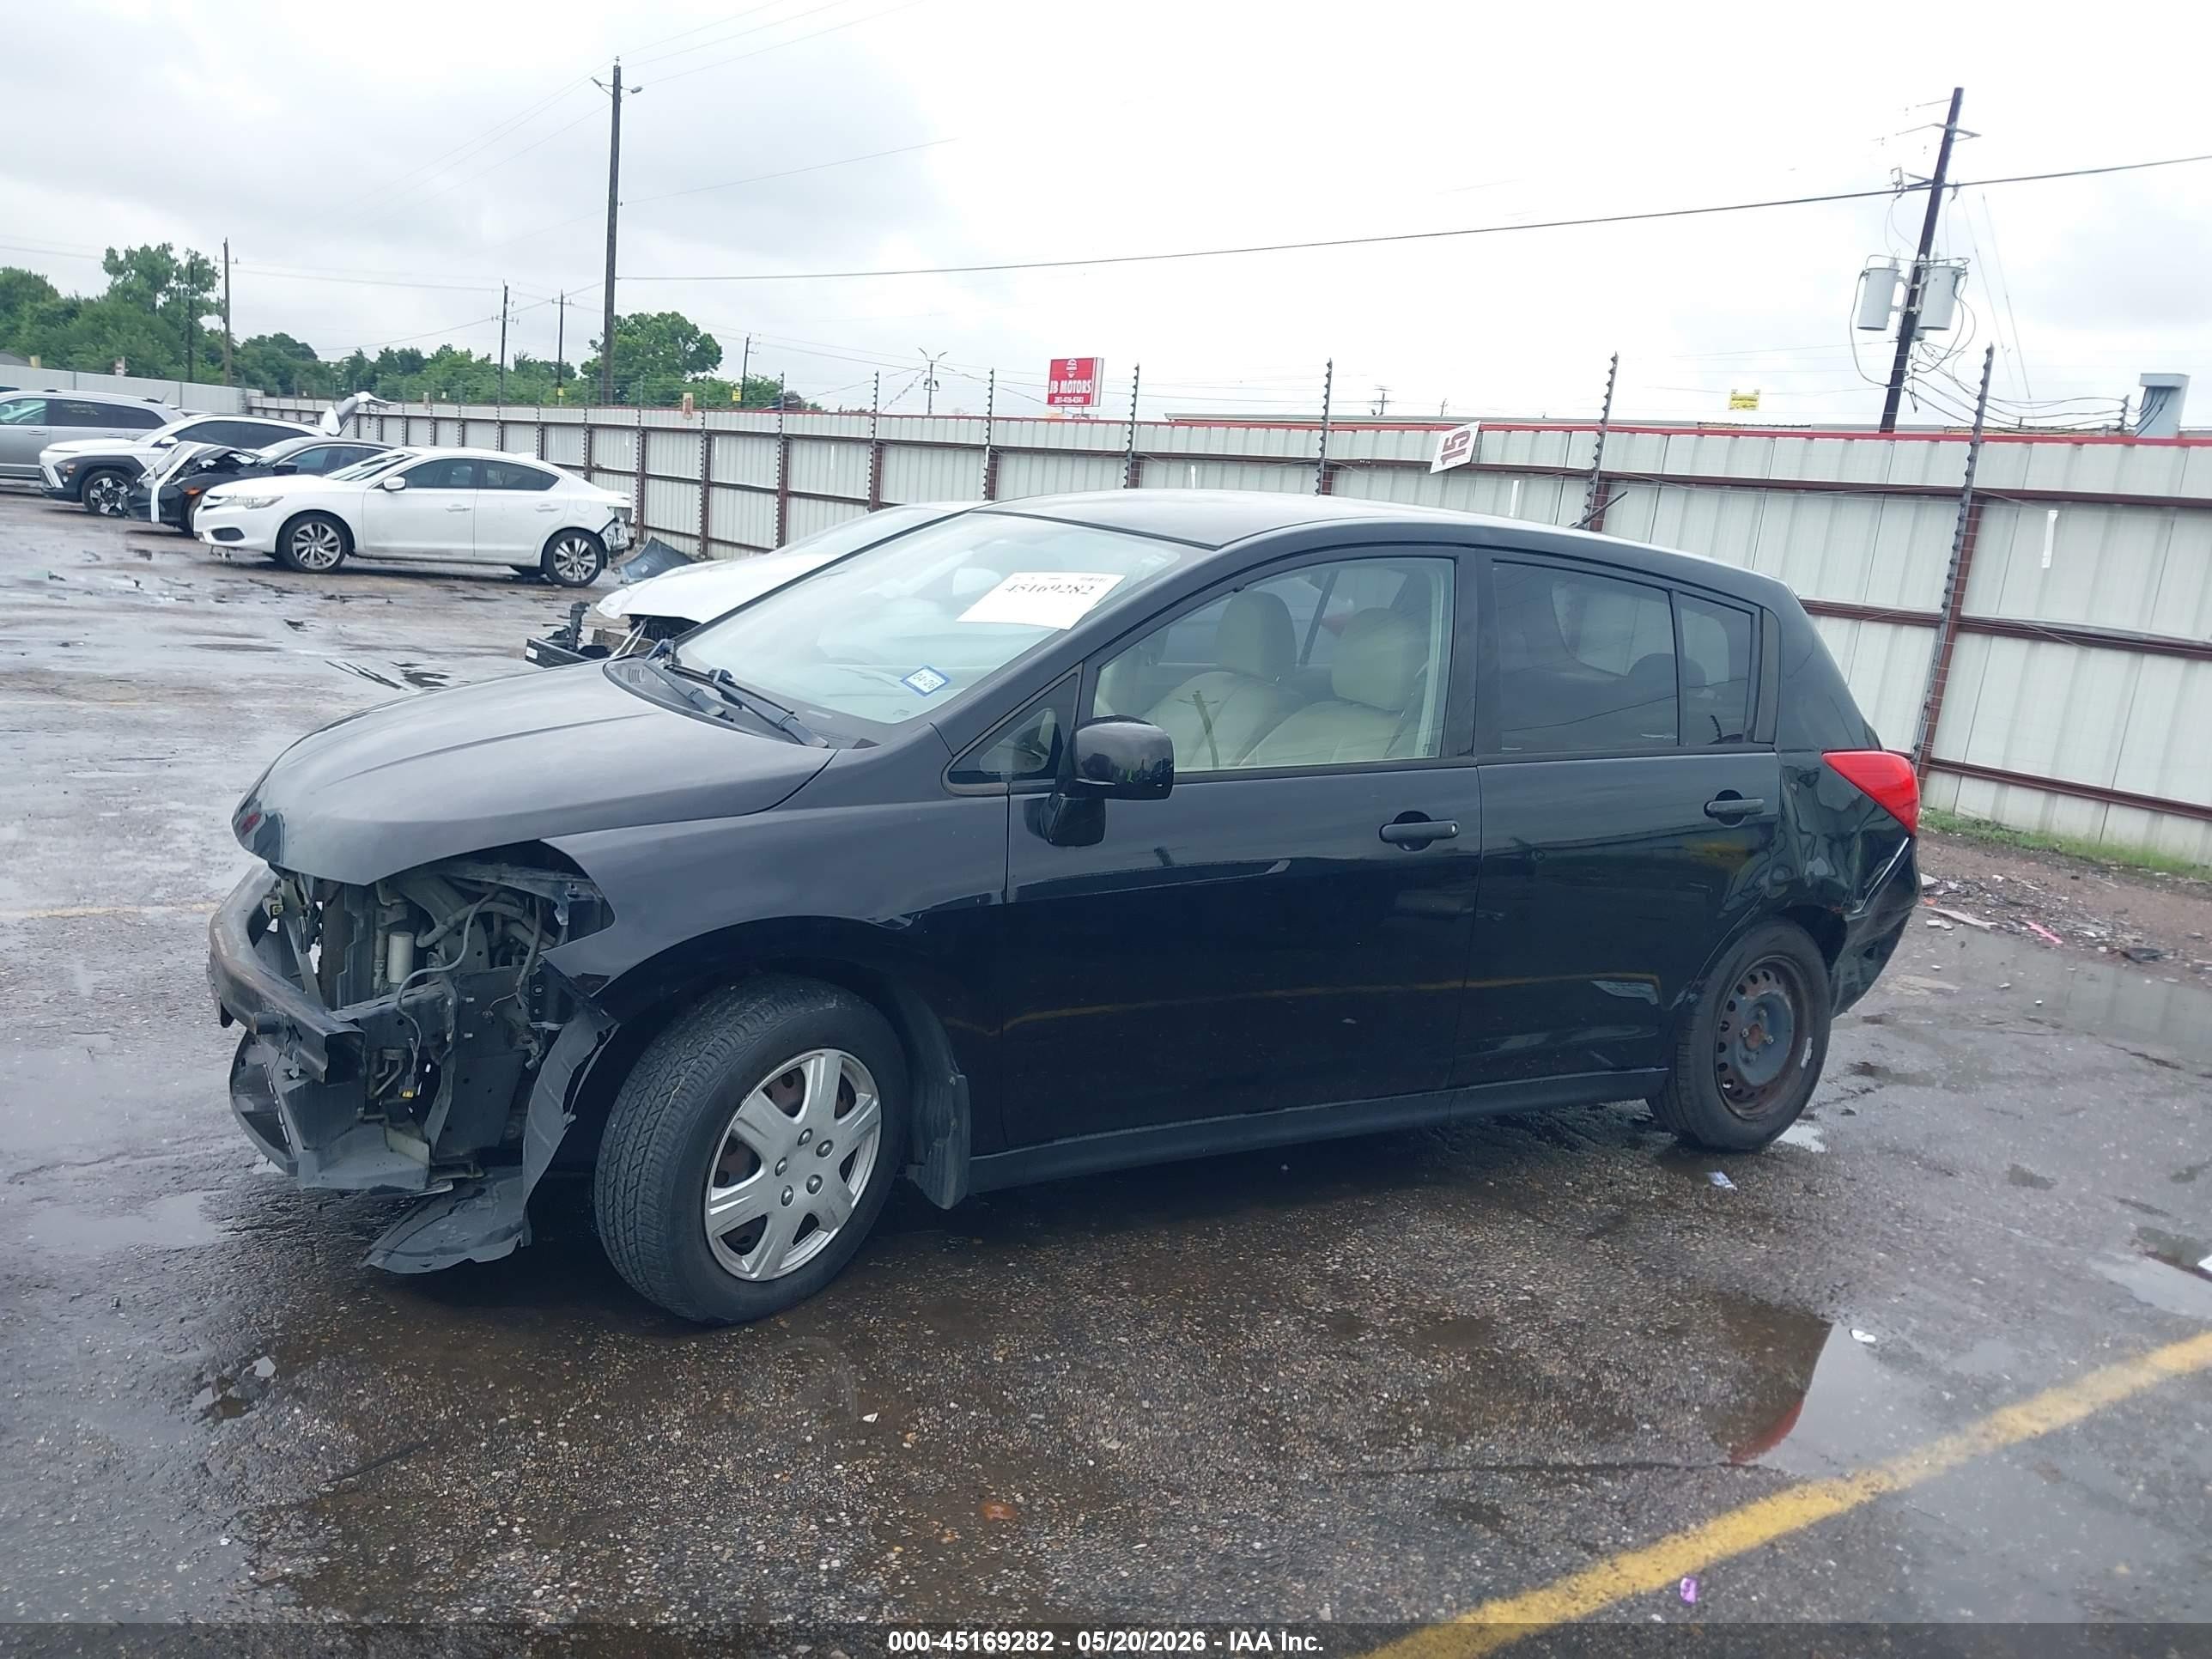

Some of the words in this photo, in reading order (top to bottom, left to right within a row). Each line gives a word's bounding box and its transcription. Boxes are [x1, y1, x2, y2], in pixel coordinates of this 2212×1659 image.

[1060, 380, 1091, 394] MOTORS
[1440, 430, 1471, 465] 15
[1006, 583, 1095, 595] 45169282
